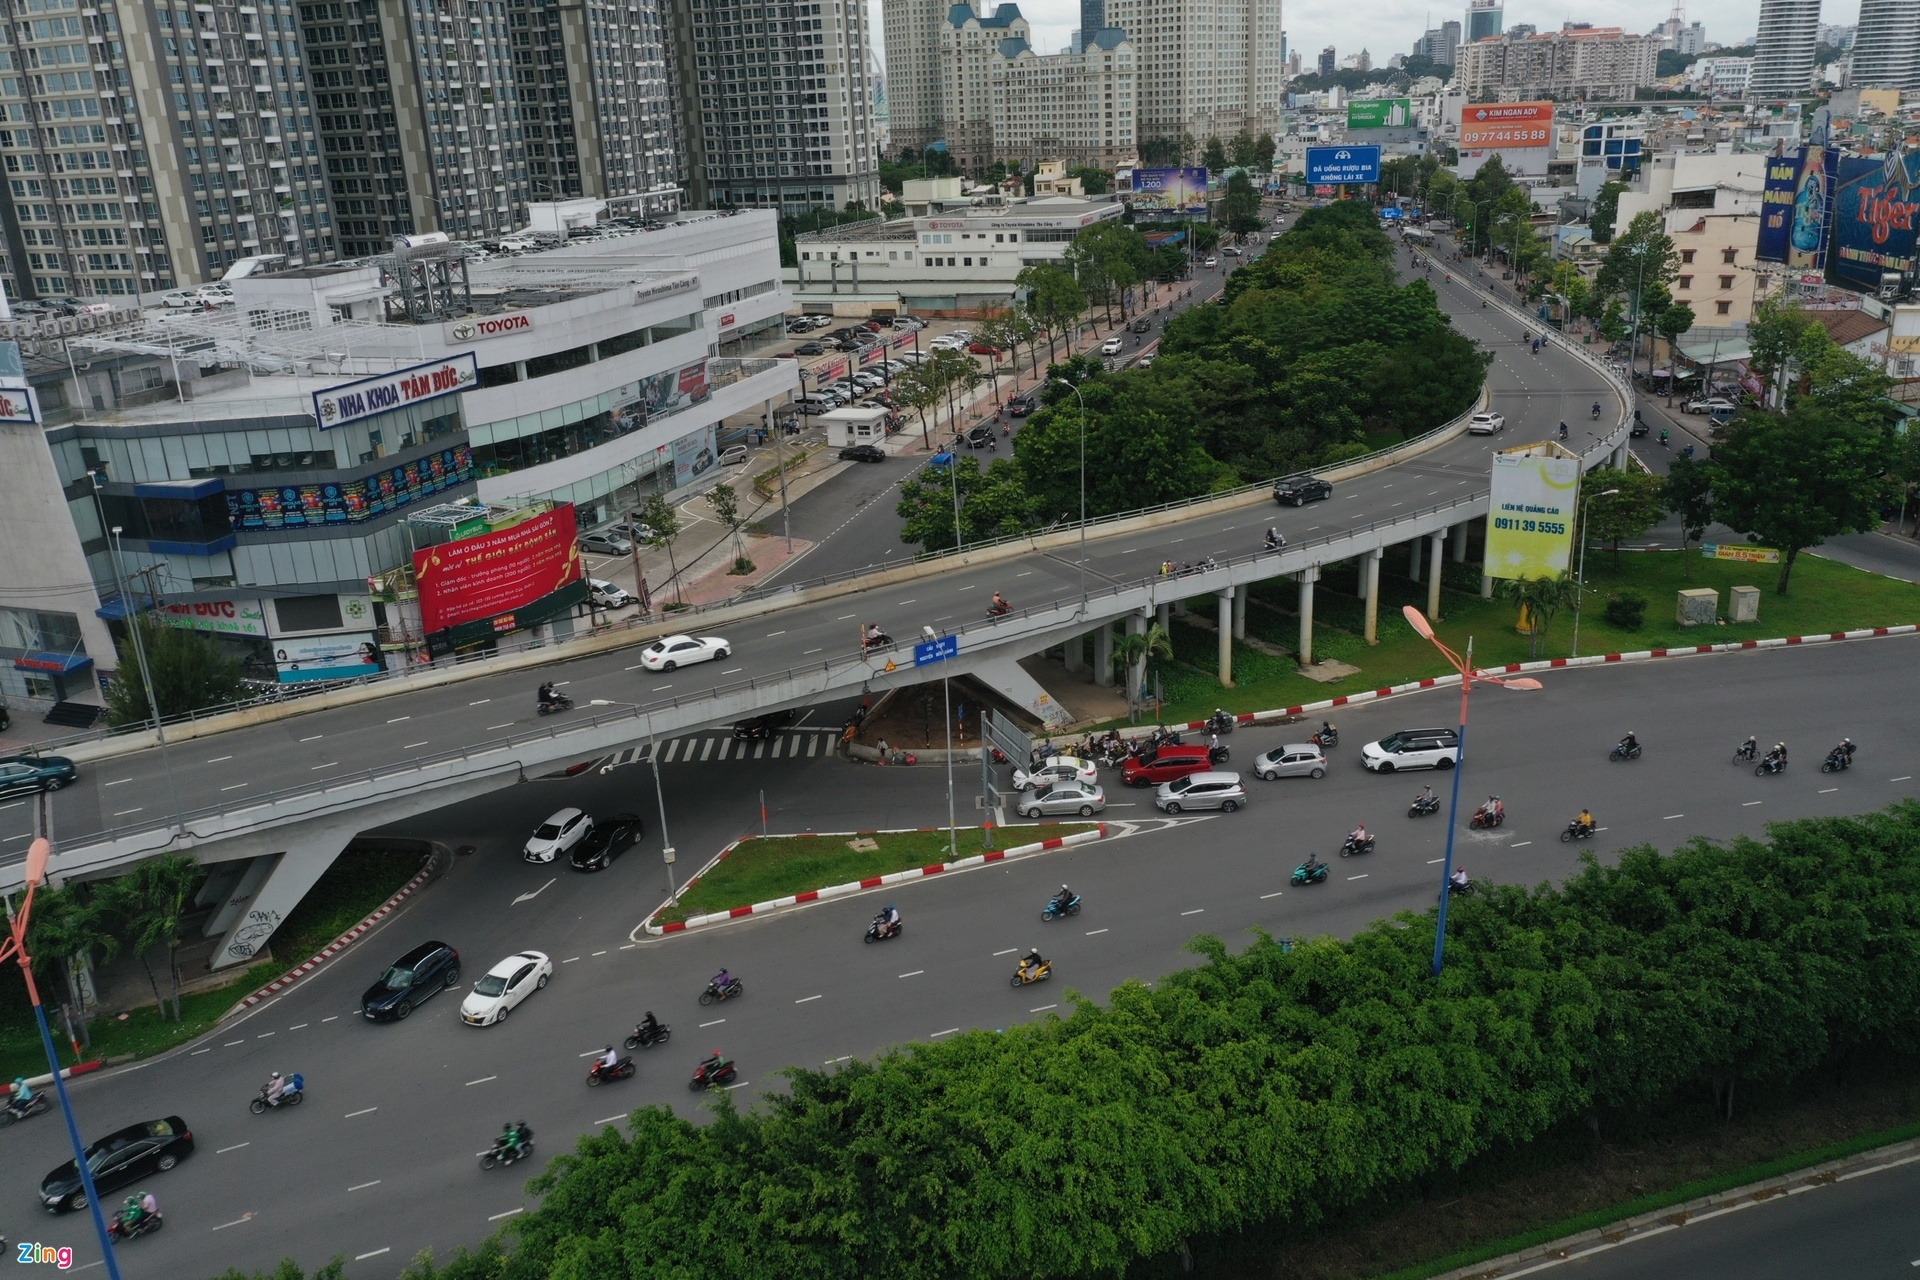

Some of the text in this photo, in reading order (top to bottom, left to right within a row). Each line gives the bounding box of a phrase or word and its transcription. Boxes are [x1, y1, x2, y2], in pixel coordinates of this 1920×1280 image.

[1857, 185, 1919, 244] Tiger
[637, 290, 651, 299] Toyota
[651, 285, 672, 294] Hiroshima
[478, 316, 529, 335] TOYOTA
[338, 393, 365, 419] NHA
[365, 384, 399, 410] KHOA
[400, 374, 431, 400] TÂM
[434, 365, 458, 391] ĐỨC
[1516, 504, 1523, 513] HỆ
[1525, 504, 1545, 514] QUẢNG
[1547, 506, 1559, 514] CÁO
[1495, 517, 1564, 534] 0911 39 5555
[448, 548, 462, 557] LÀM
[508, 533, 520, 541] MUA
